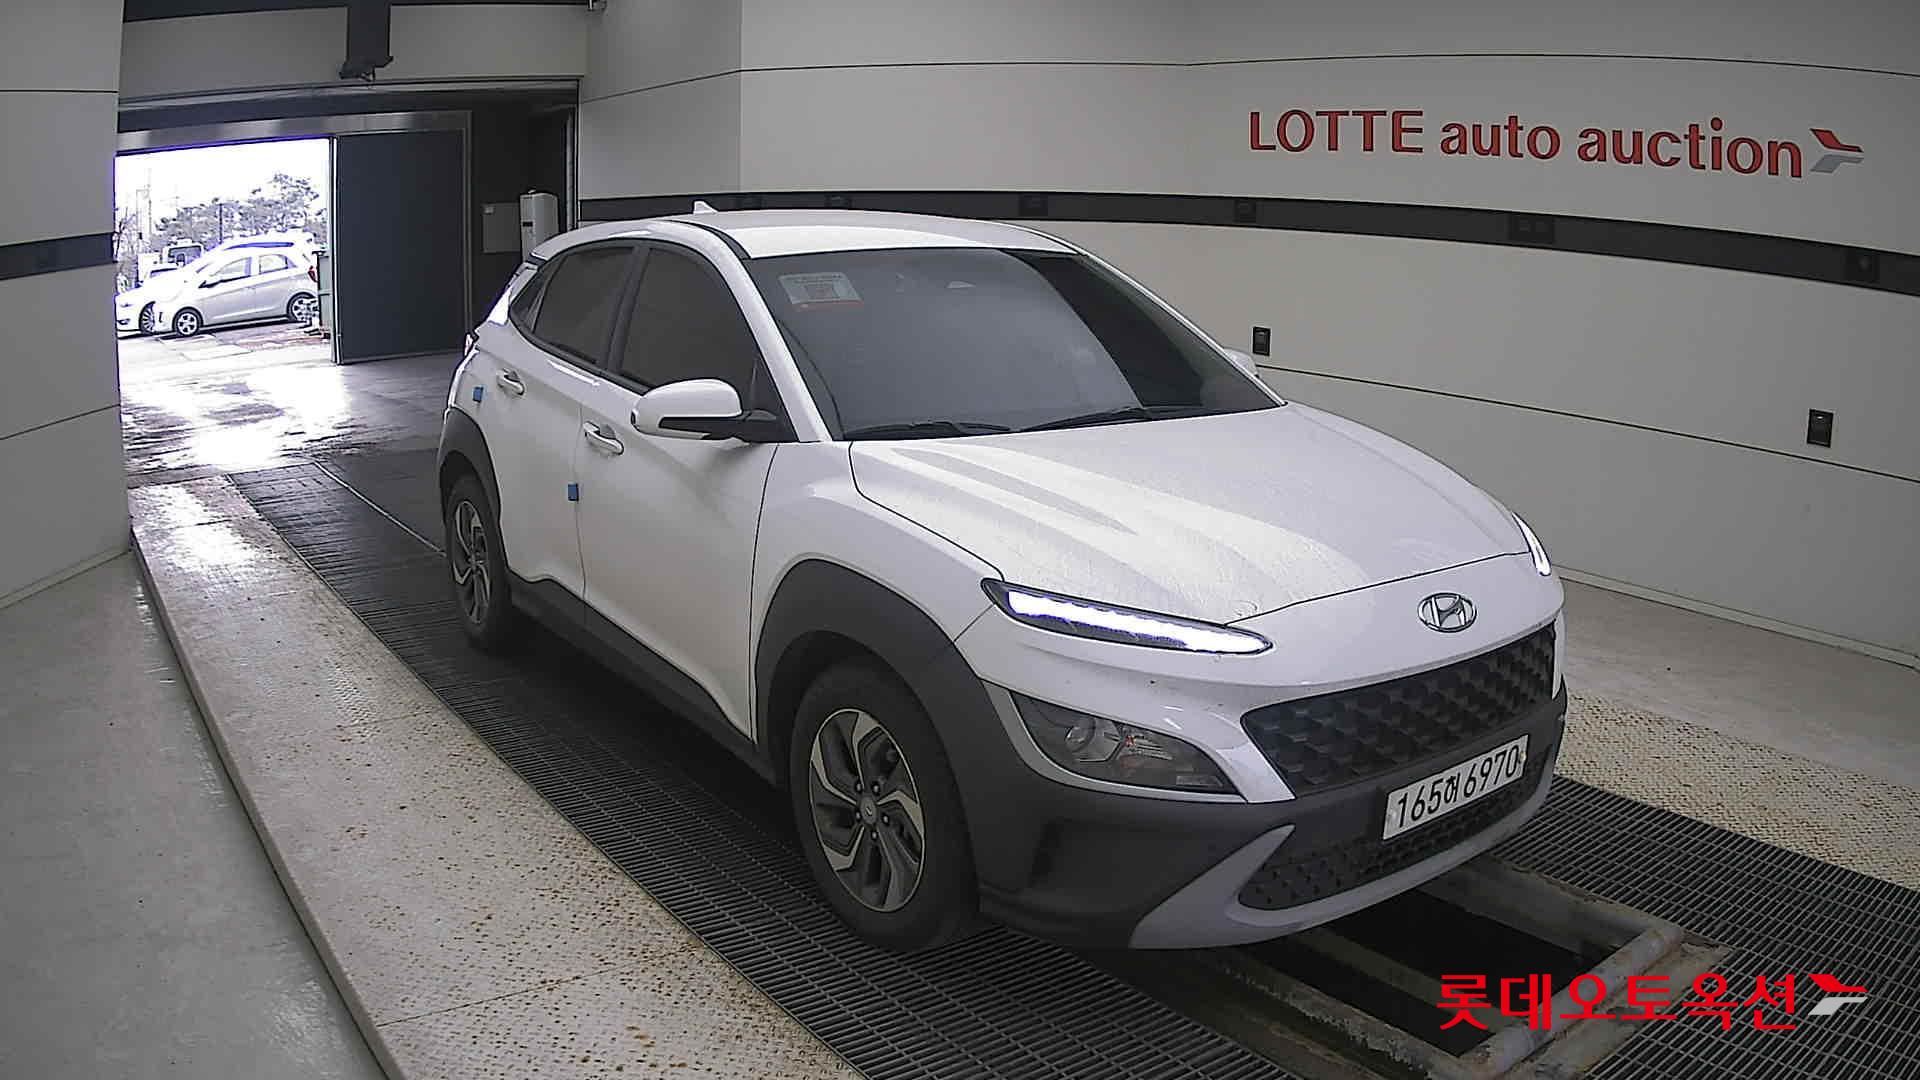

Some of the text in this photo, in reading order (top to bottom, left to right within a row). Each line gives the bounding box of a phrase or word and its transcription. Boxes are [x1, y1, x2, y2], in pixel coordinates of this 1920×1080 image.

[1249, 110, 1803, 178] LOTTE auto auction
